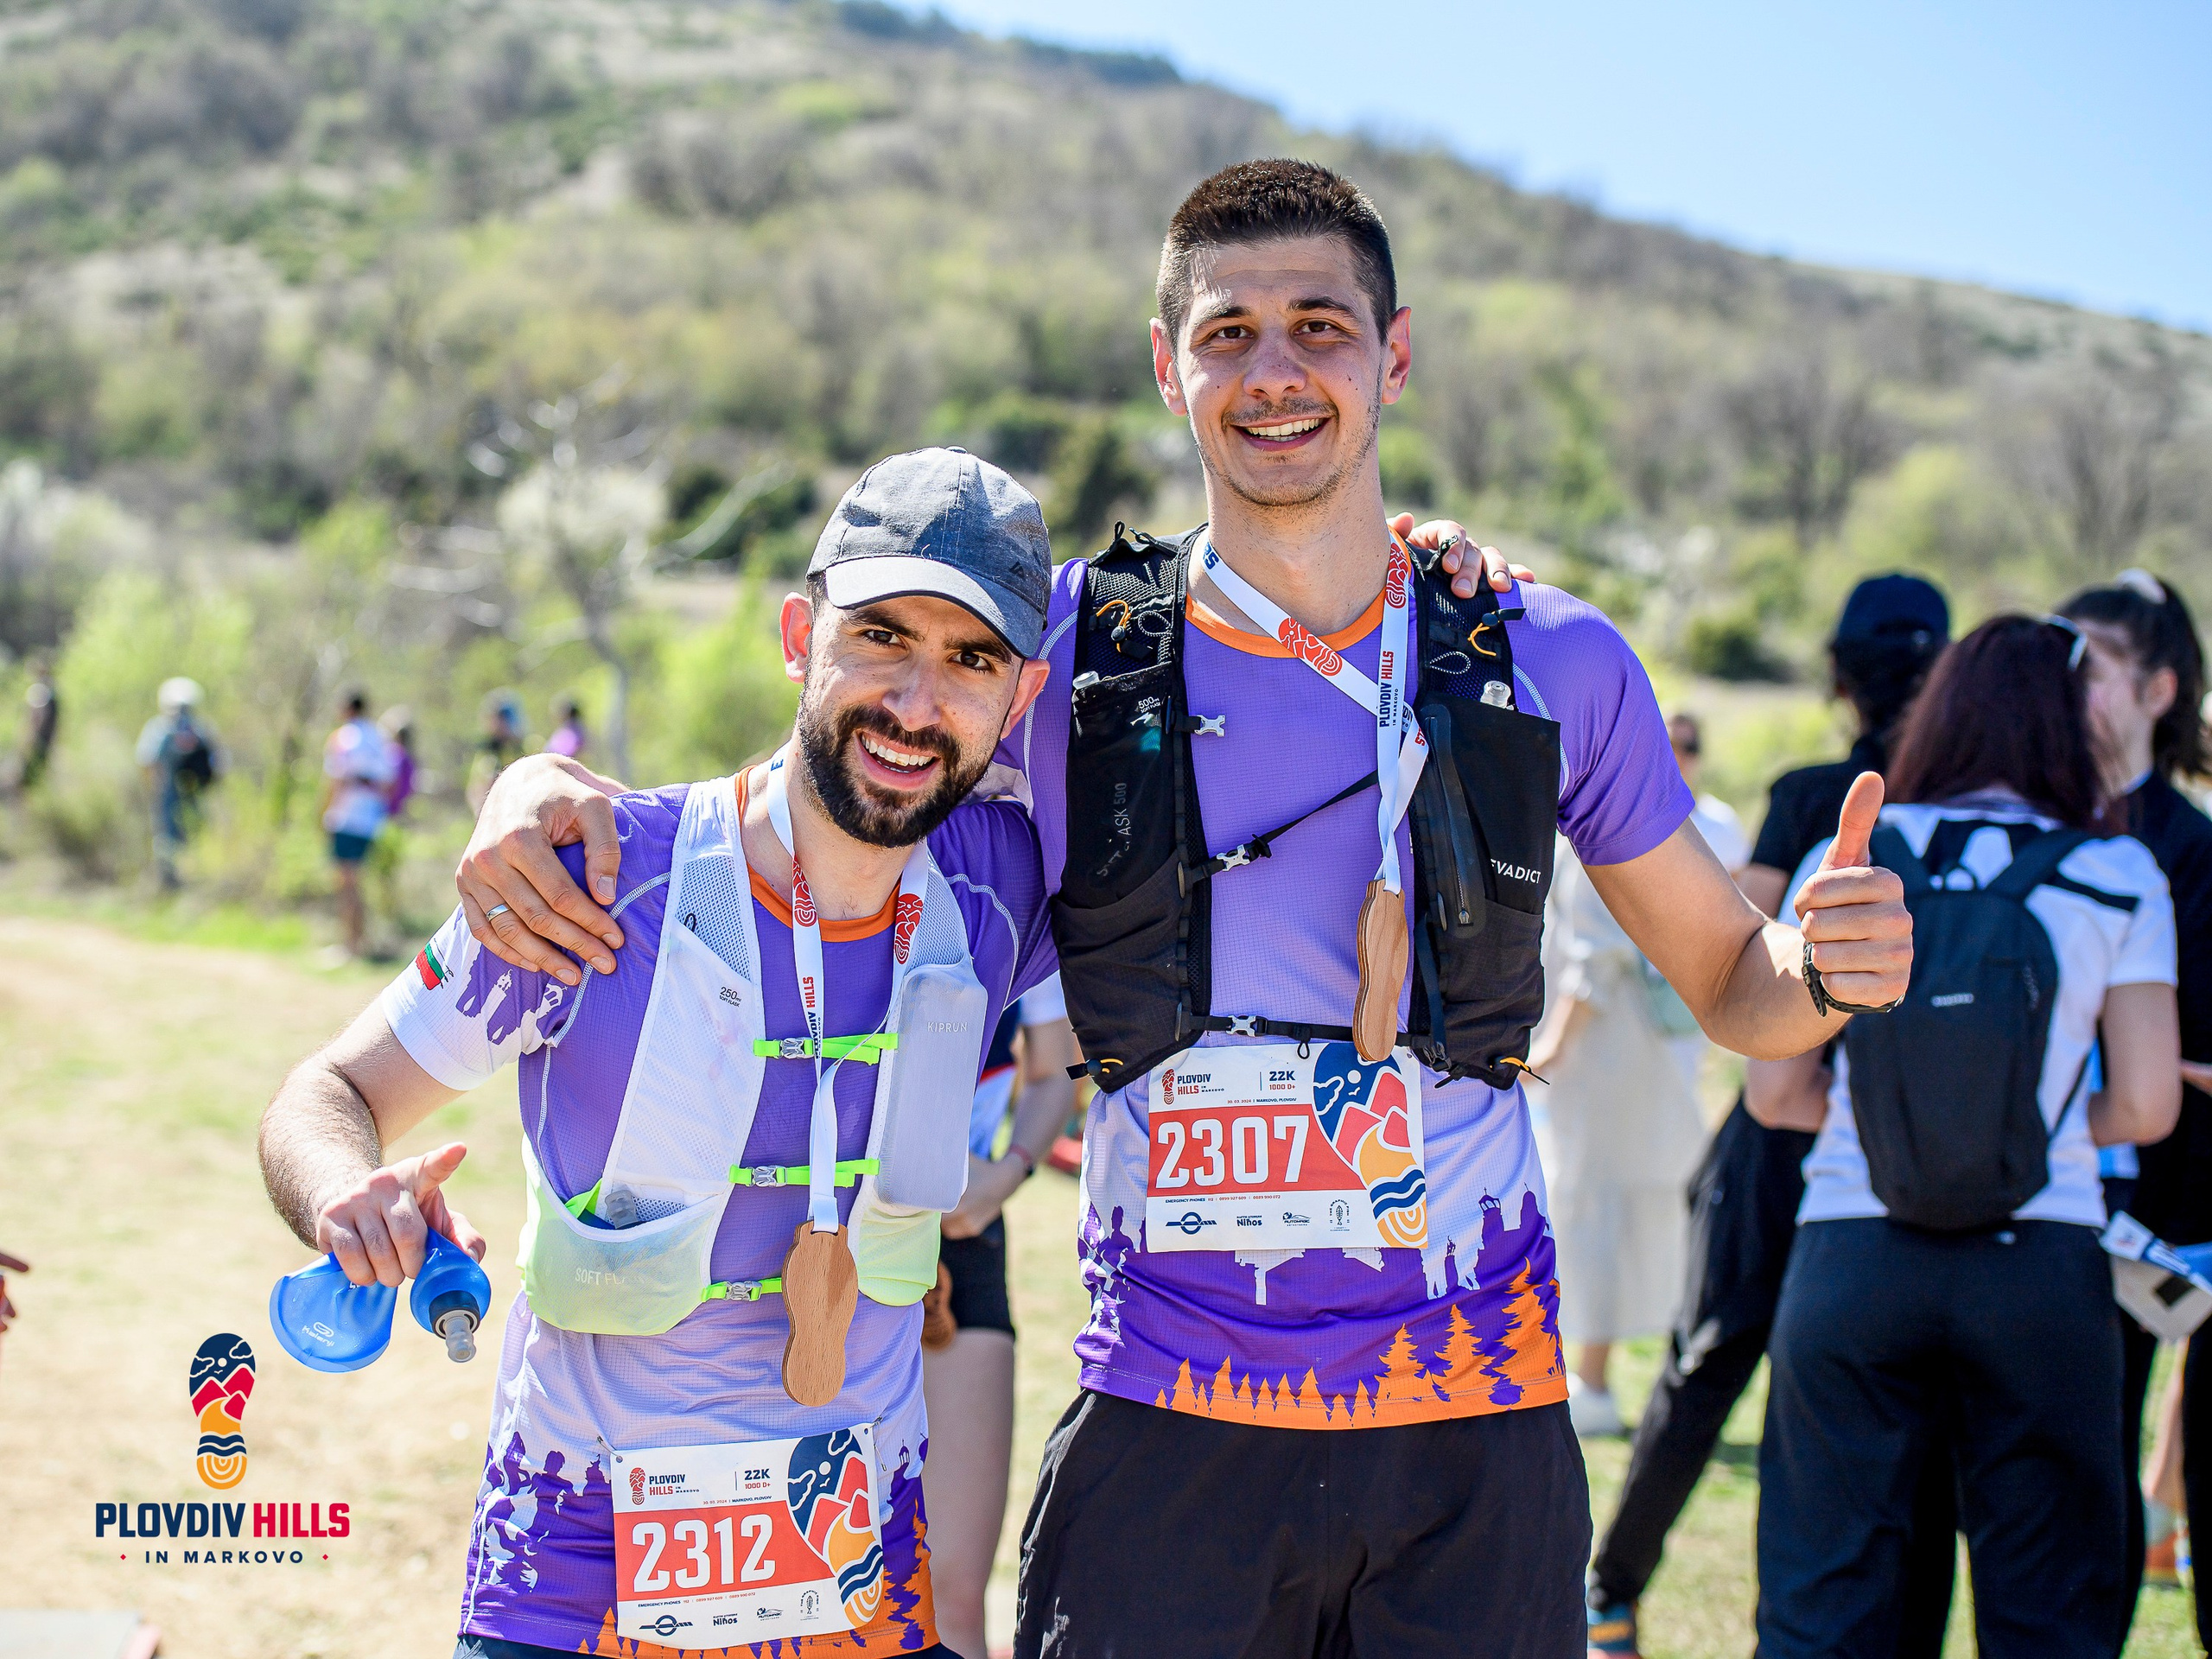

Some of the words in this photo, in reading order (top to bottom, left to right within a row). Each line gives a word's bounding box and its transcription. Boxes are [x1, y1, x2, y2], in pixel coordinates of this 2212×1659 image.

[1381, 651, 1394, 679] HILLS
[1380, 683, 1392, 728] PLOVDIV
[803, 976, 815, 1008] HILLS
[927, 1021, 968, 1033] KIPRUN
[1177, 1073, 1211, 1084] PLOVDIV
[1268, 1071, 1295, 1081] 22K
[1178, 1084, 1199, 1095] HILLS
[1155, 1115, 1310, 1188] 2307
[649, 1474, 685, 1484] PLOVDIV
[744, 1468, 770, 1480] 22K
[649, 1485, 673, 1496] HILLS
[632, 1514, 776, 1592] 2312
